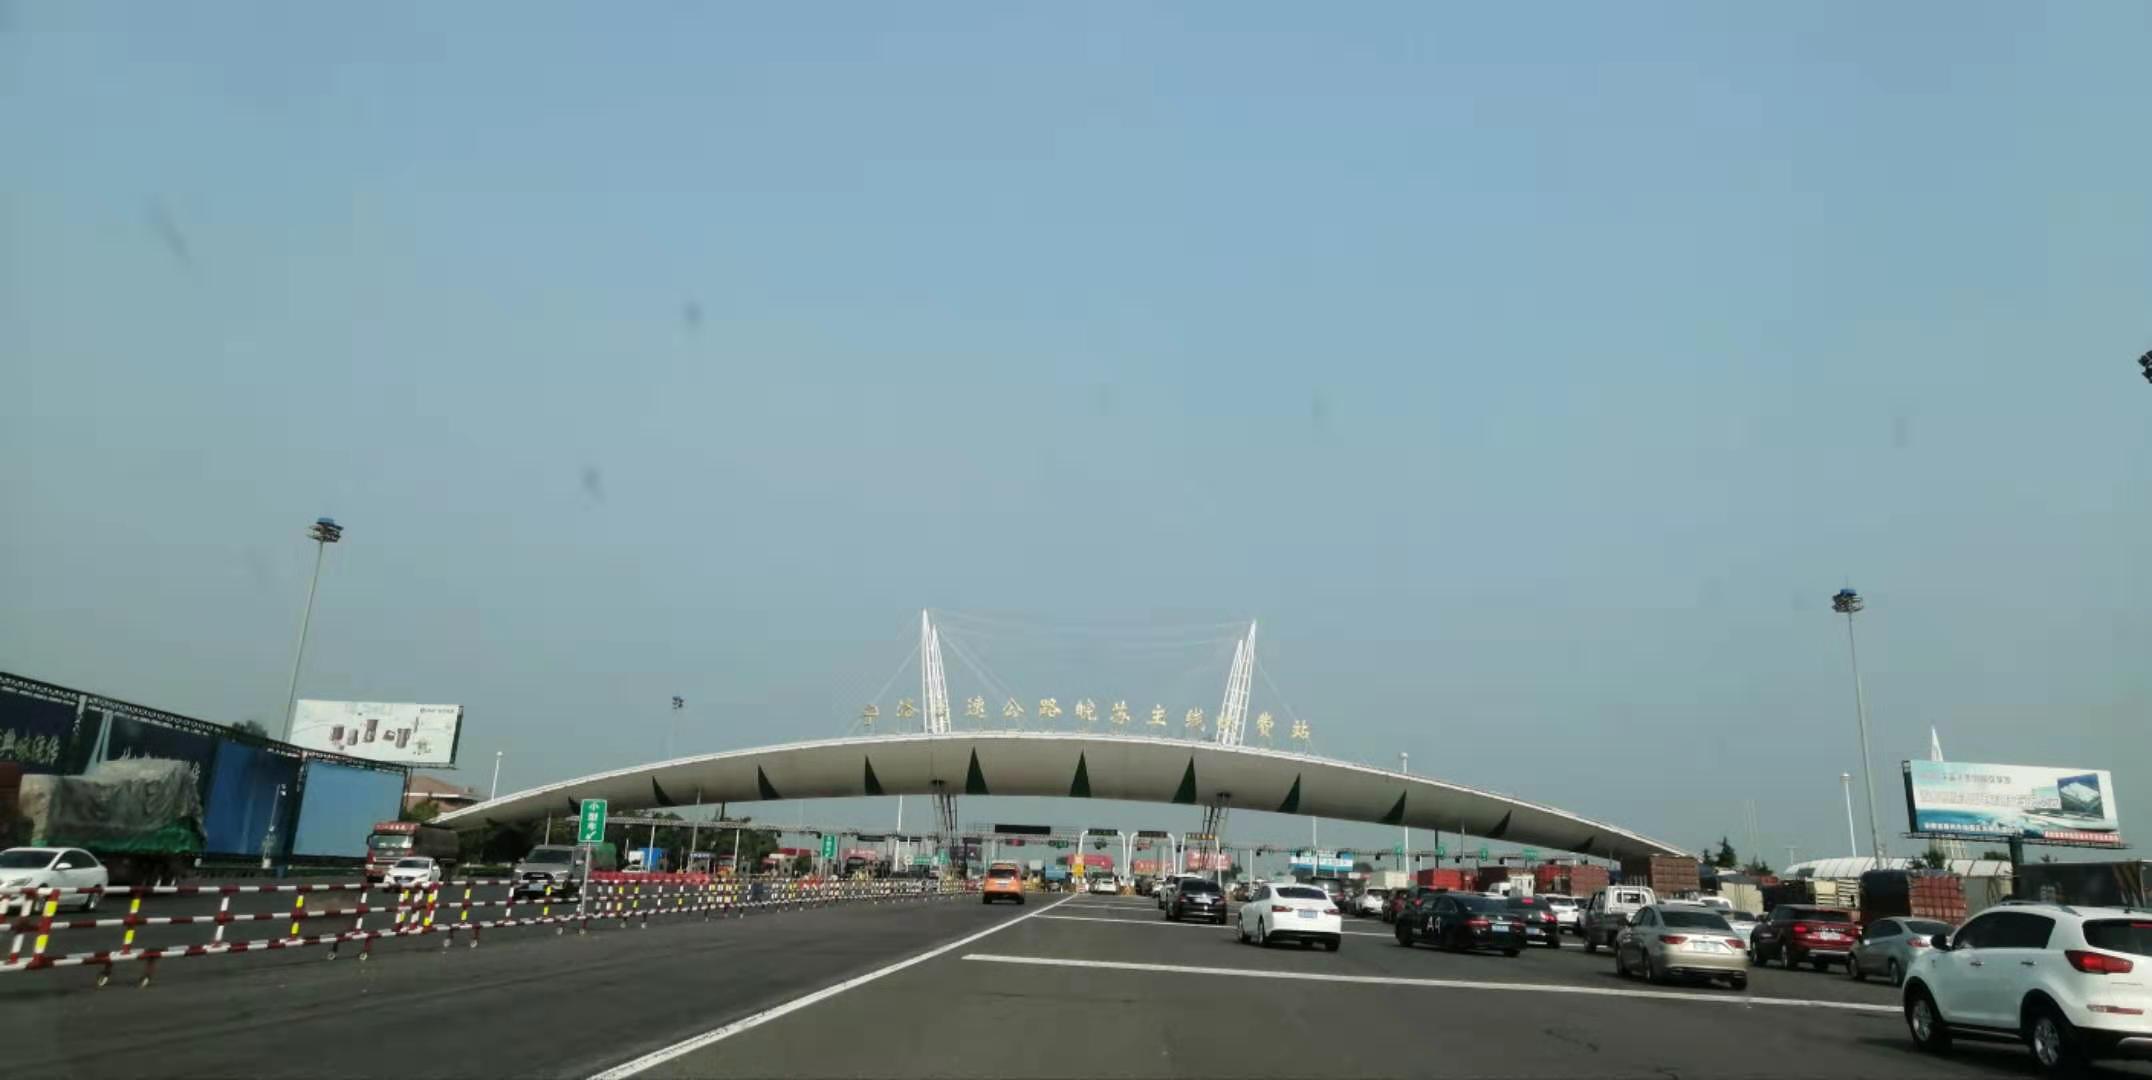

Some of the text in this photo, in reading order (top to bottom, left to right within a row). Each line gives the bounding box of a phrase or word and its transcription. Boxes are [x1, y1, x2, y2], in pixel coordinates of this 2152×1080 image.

[863, 696, 1311, 740] 宁洛速公路皖苏主线费站
